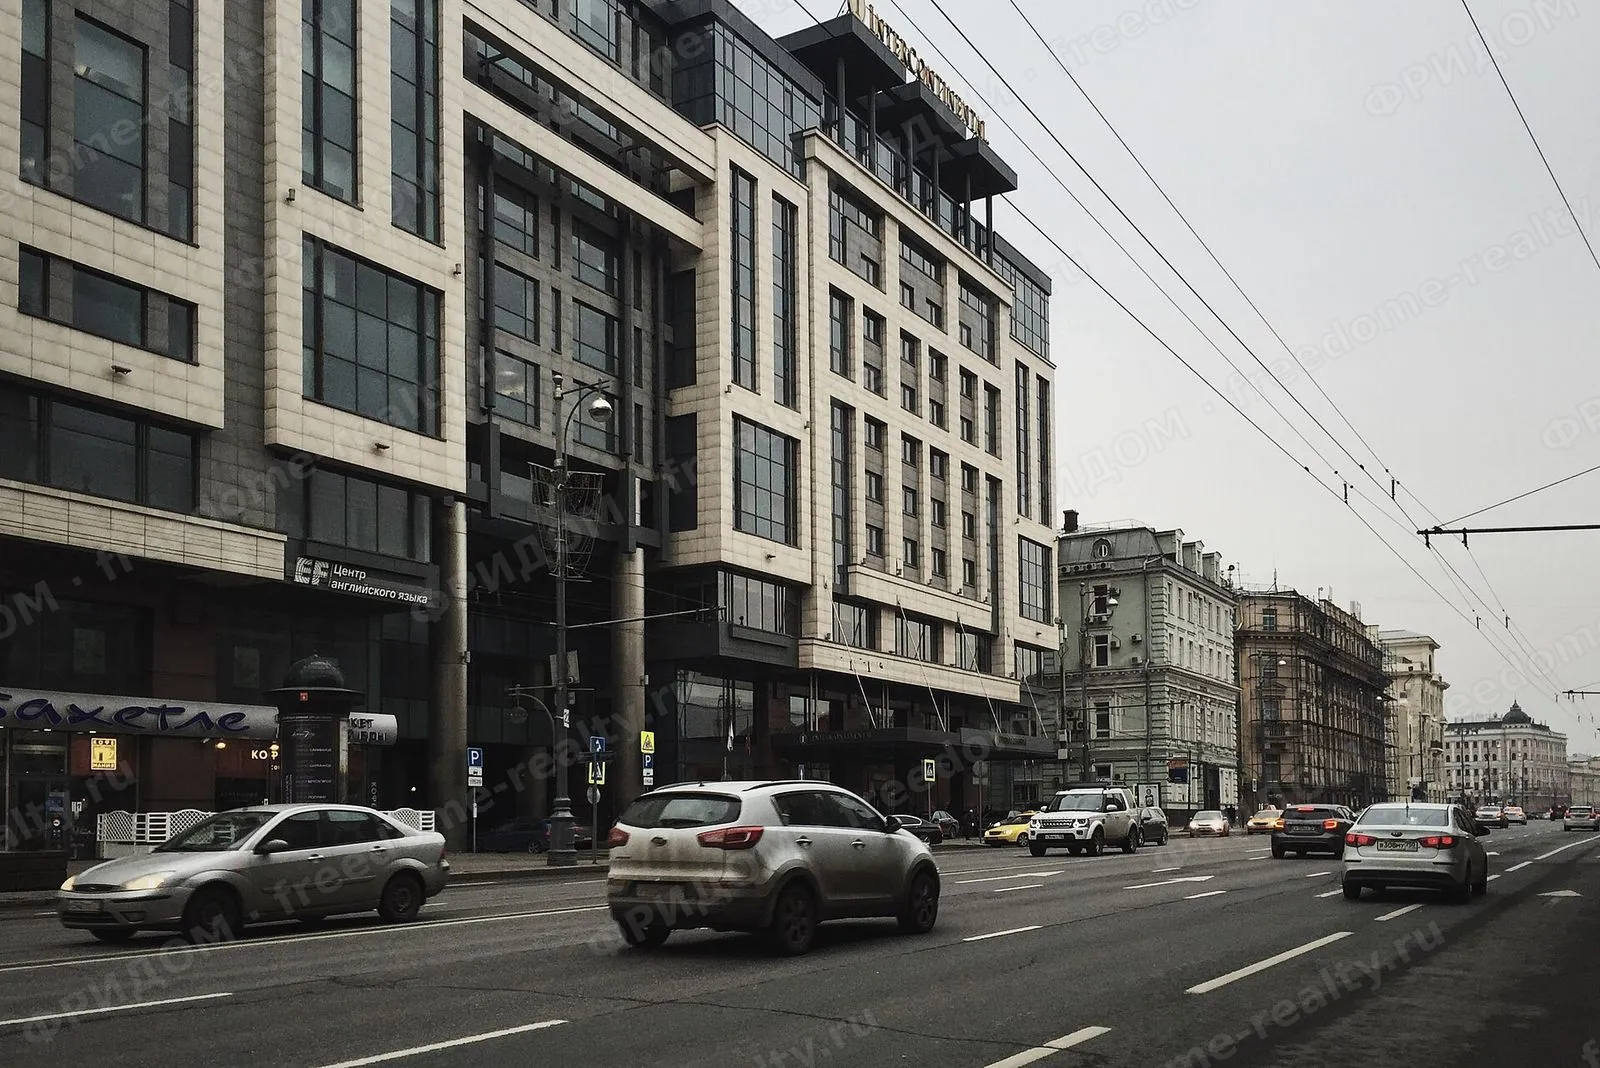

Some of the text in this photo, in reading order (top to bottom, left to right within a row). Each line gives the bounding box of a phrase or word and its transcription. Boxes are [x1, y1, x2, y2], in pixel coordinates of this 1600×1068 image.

[333, 563, 366, 581] Центр
[331, 579, 428, 605] английского языка
[471, 750, 479, 765] P
[645, 754, 652, 767] P
